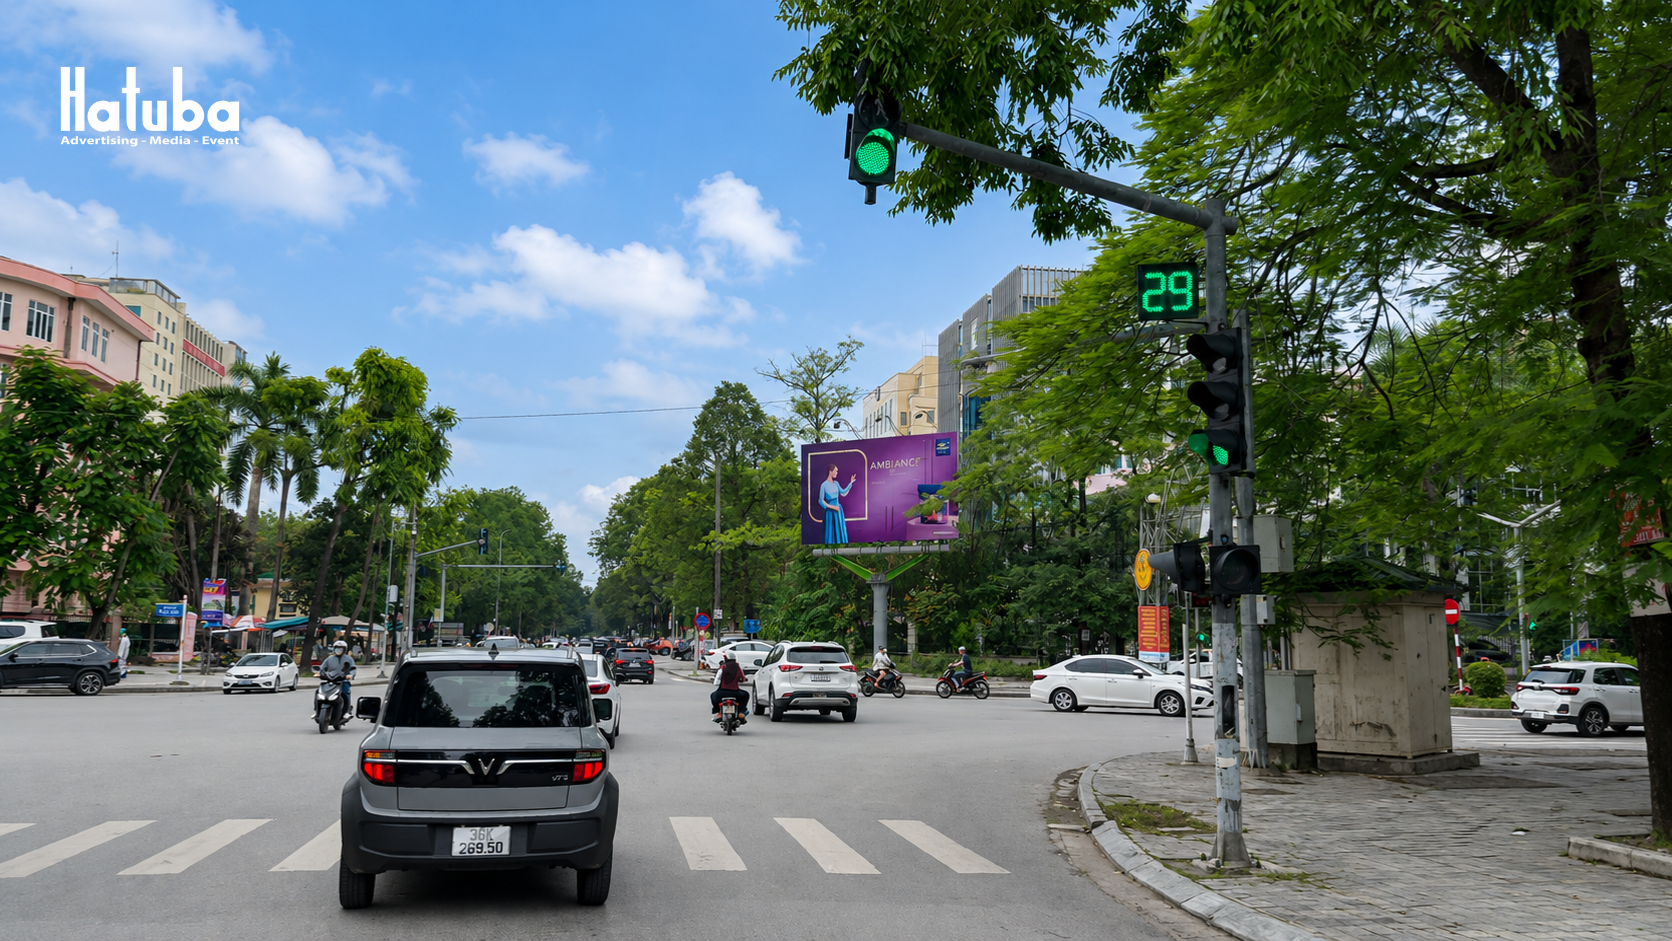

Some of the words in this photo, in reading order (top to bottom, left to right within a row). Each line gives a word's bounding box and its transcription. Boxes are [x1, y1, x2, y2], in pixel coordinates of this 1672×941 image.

[1142, 270, 1193, 312] 29
[470, 828, 494, 841] 36K
[459, 841, 504, 855] 269.50
